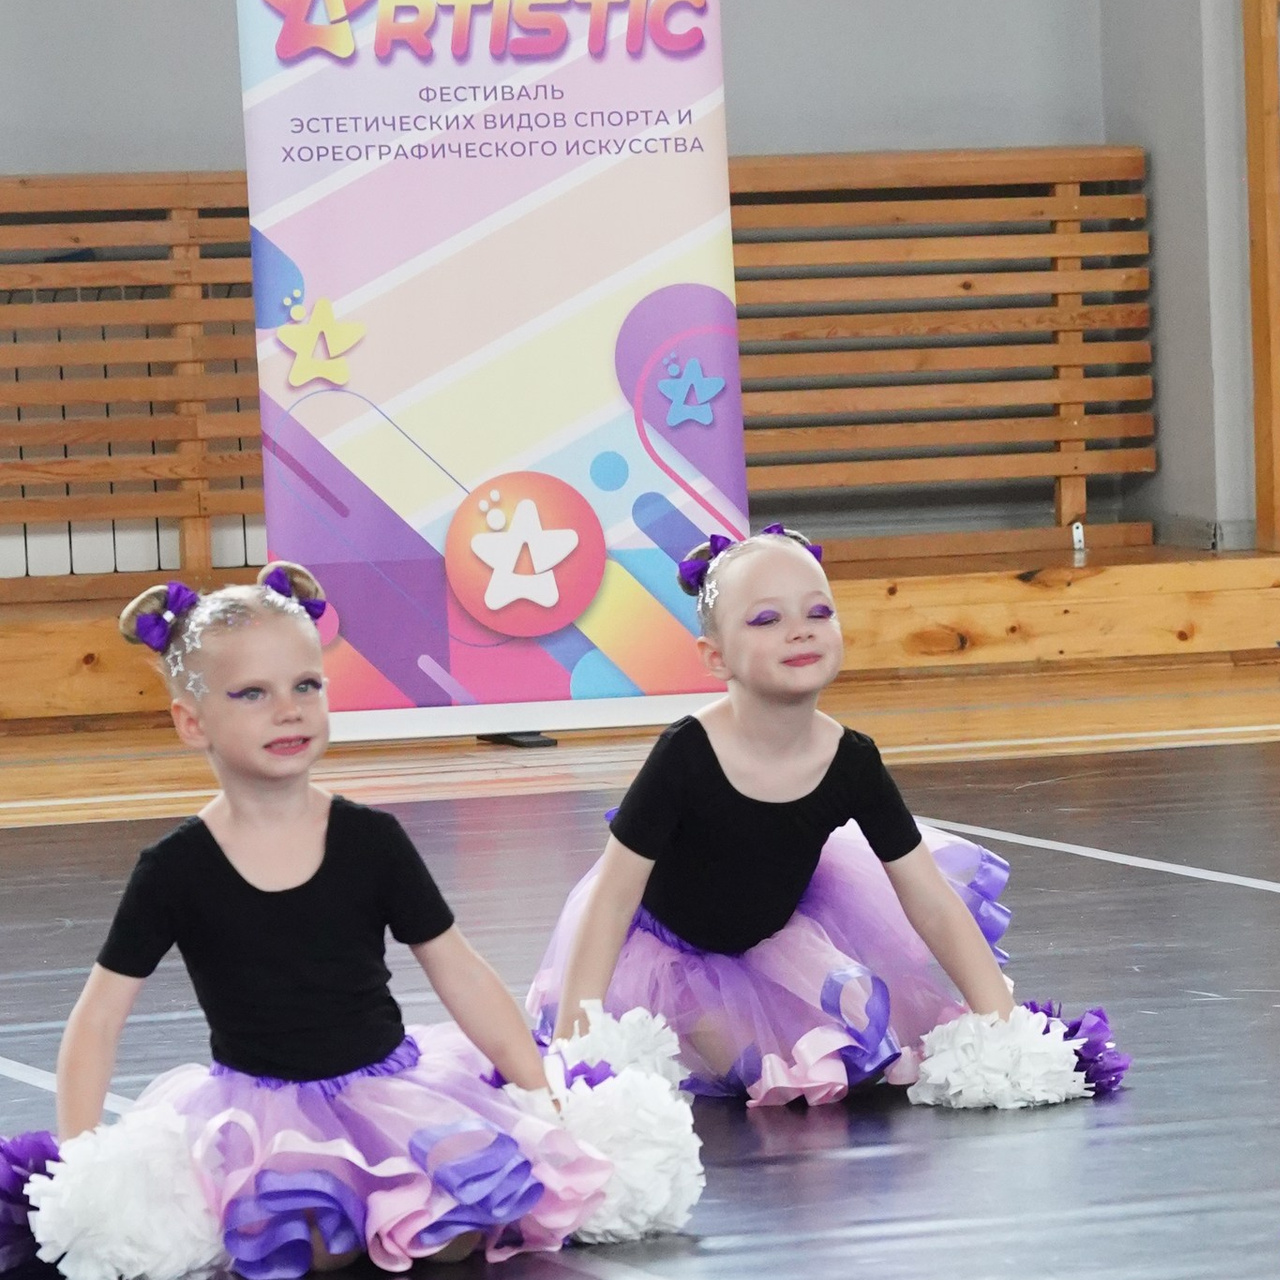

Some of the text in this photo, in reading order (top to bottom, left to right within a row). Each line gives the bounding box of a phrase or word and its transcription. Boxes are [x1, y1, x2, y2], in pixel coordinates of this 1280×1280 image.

[418, 84, 565, 104] ФЕСТИВАЛЬ
[290, 109, 693, 135] ЭСТЕТИЧЕСКИХ ВИДОВ СПОРТА И
[281, 136, 705, 164] ХОРЕОГРАФИЧЕСКОГО ИСКУССТВА
